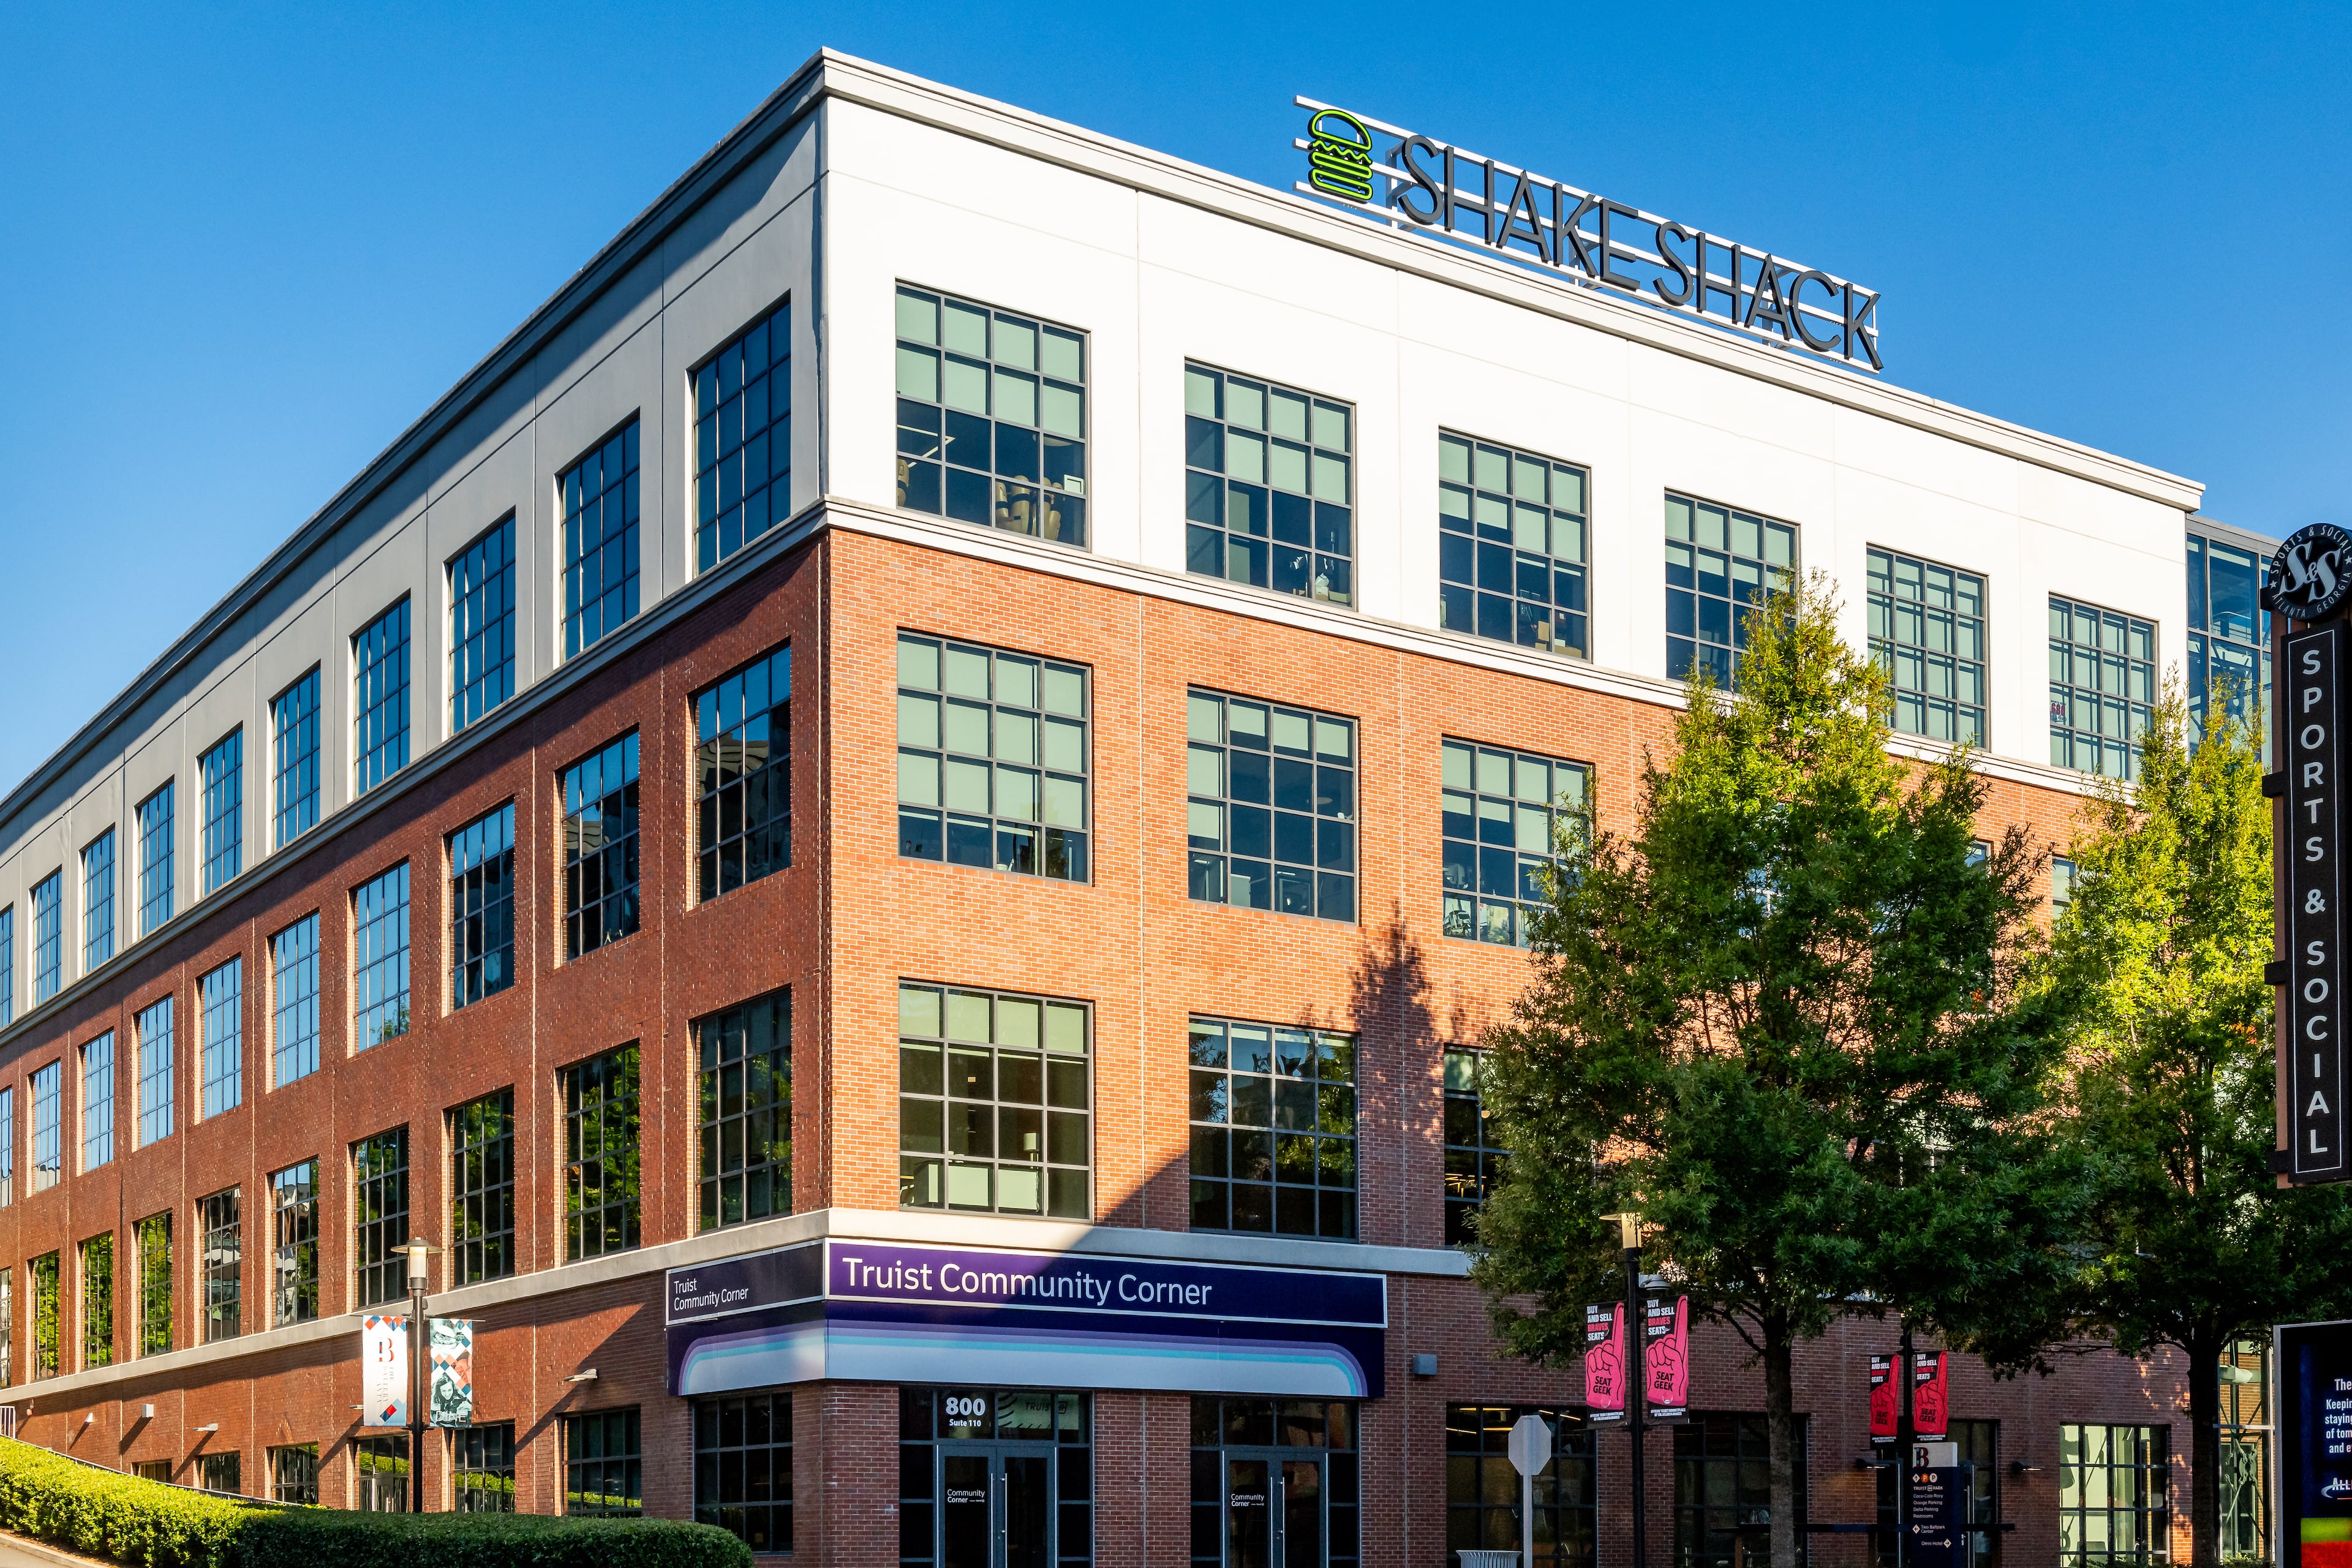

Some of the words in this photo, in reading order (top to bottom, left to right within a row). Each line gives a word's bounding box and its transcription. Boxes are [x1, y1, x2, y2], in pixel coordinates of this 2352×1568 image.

[1397, 135, 1641, 290] SHAKE
[1653, 221, 1884, 370] SHACK
[2270, 532, 2302, 575] SPORTS
[2309, 526, 2315, 537] &
[2320, 525, 2352, 554] SOCIAL
[2271, 594, 2306, 618] ATLANTA
[2316, 571, 2352, 613] GEORGIA
[2051, 703, 2065, 716] 680
[2301, 649, 2325, 861] SPORTS
[2305, 889, 2326, 914] &
[2304, 941, 2330, 1154] SOCIAL
[674, 1278, 697, 1294] Truist
[842, 1257, 932, 1291] Truist
[940, 1263, 1111, 1306] Community
[1118, 1274, 1212, 1305] Corner
[674, 1291, 720, 1311] Community
[721, 1287, 748, 1303] Corner
[1647, 1299, 1659, 1308] BUY
[1587, 1305, 1598, 1314] BUY
[1648, 1308, 1660, 1317] AND
[1660, 1306, 1675, 1316] SELL
[1588, 1314, 1599, 1323] AND
[1599, 1313, 1613, 1322] SELL
[1648, 1316, 1670, 1326] BRAVES
[1588, 1323, 1608, 1332] BRAVES
[1648, 1325, 1666, 1335] SEATS
[1588, 1332, 1604, 1341] SEATS
[376, 1337, 395, 1362] B
[1595, 1376, 1612, 1386] SEAT
[1656, 1371, 1675, 1382] SEAT
[1654, 1381, 1673, 1392] GEEK
[2334, 1379, 2352, 1390] The
[1593, 1385, 1611, 1396] GEEK
[946, 1397, 986, 1416] 800
[1025, 1401, 1050, 1411] TRUIS
[435, 1411, 467, 1422] DINE
[1920, 1415, 1936, 1423] GEEK
[2326, 1428, 2335, 1439] of
[2329, 1442, 2345, 1453] and
[1913, 1447, 1929, 1468] B
[947, 1489, 985, 1498] Community
